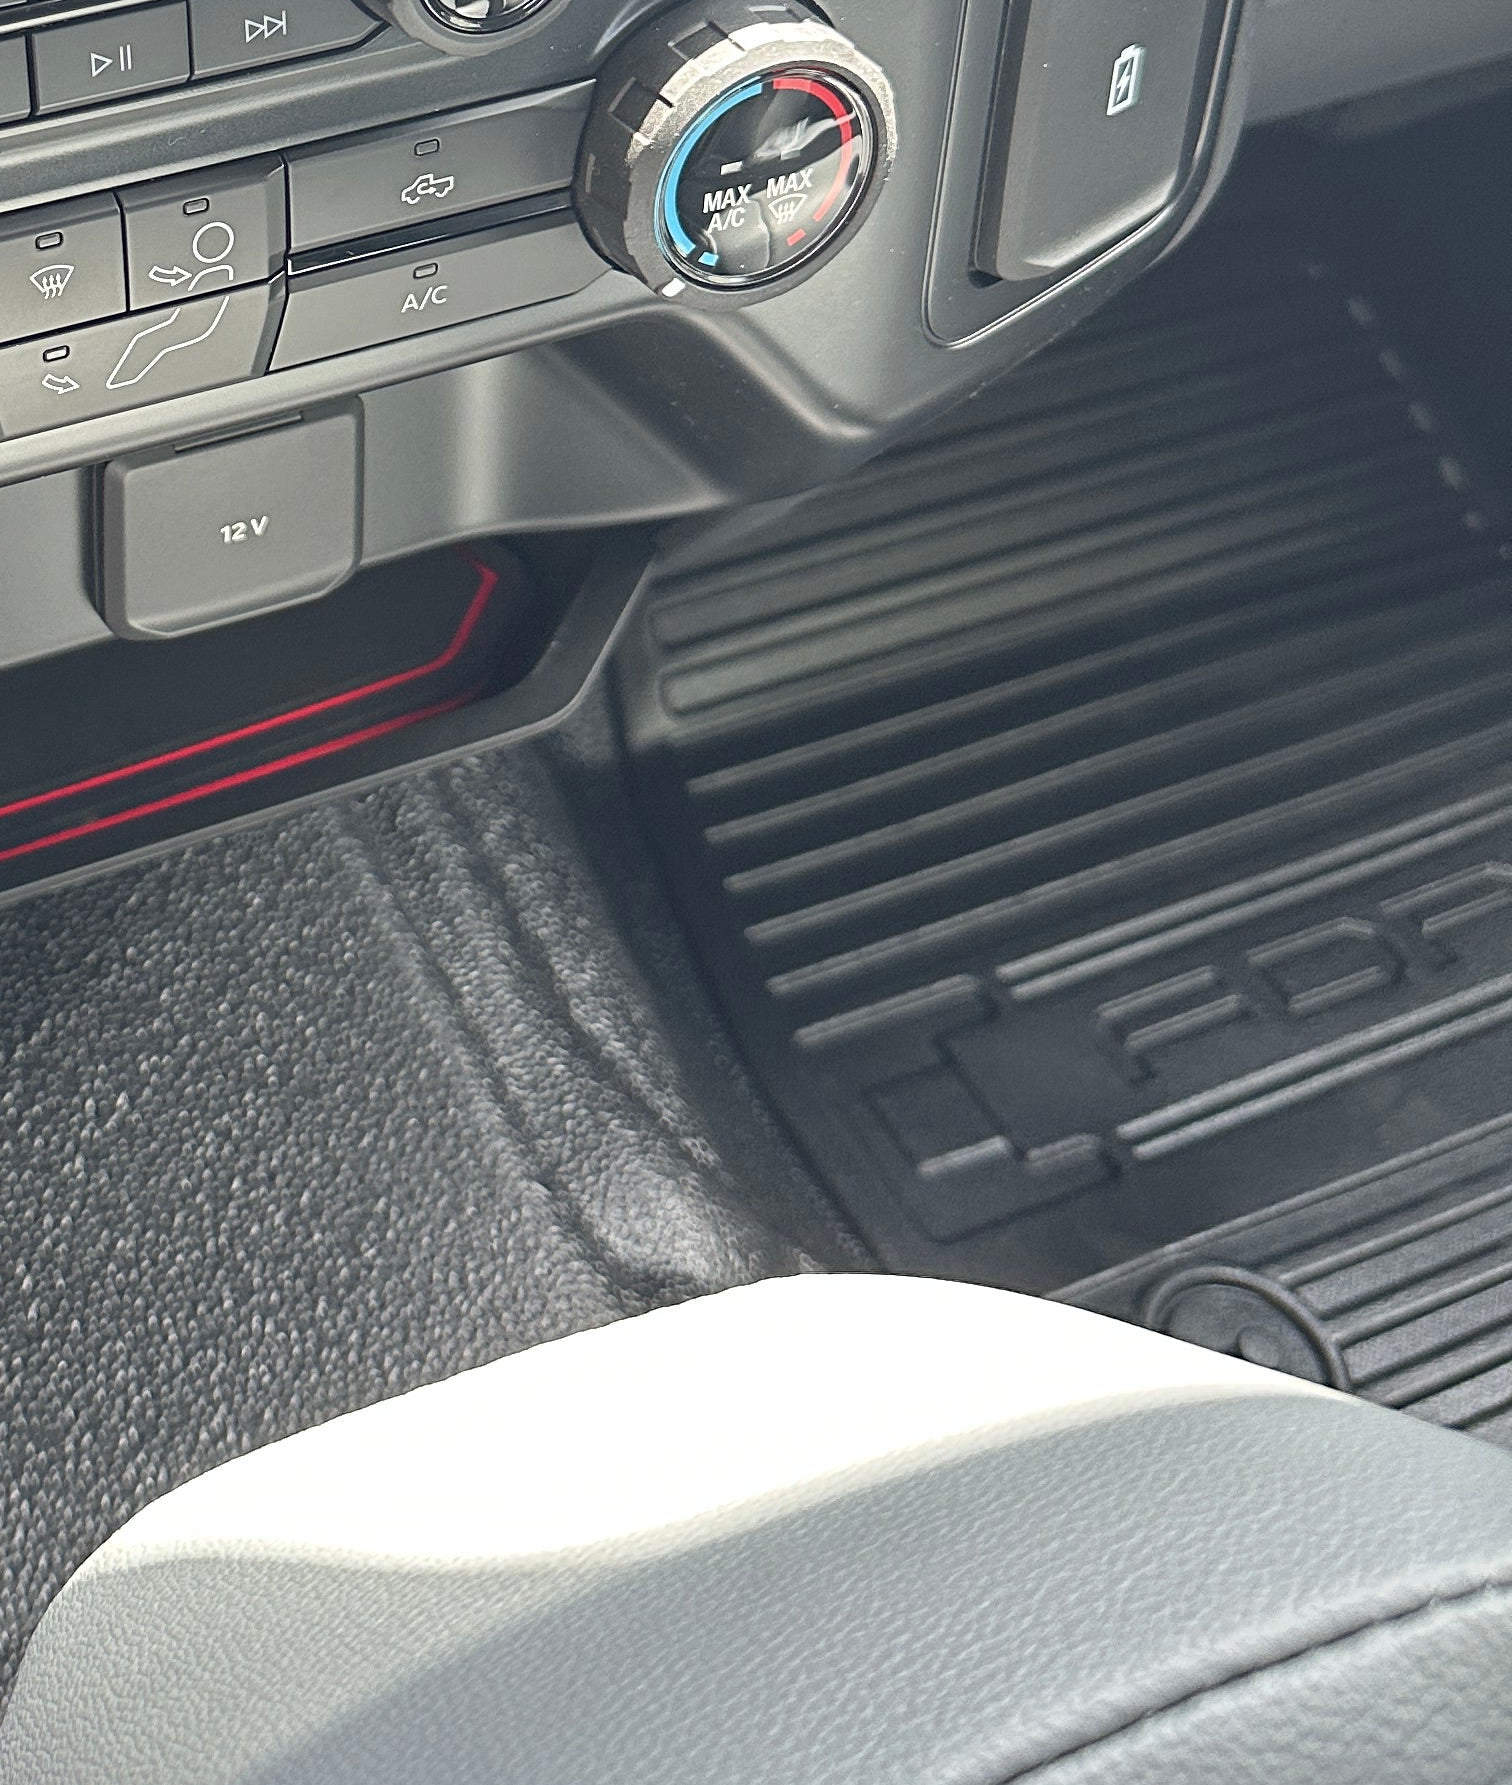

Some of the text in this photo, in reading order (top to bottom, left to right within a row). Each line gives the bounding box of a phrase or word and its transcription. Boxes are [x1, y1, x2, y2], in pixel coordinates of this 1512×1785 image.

[766, 168, 814, 198] MAX
[703, 183, 752, 214] MAX
[707, 207, 746, 234] A/C
[400, 285, 448, 313] A/C
